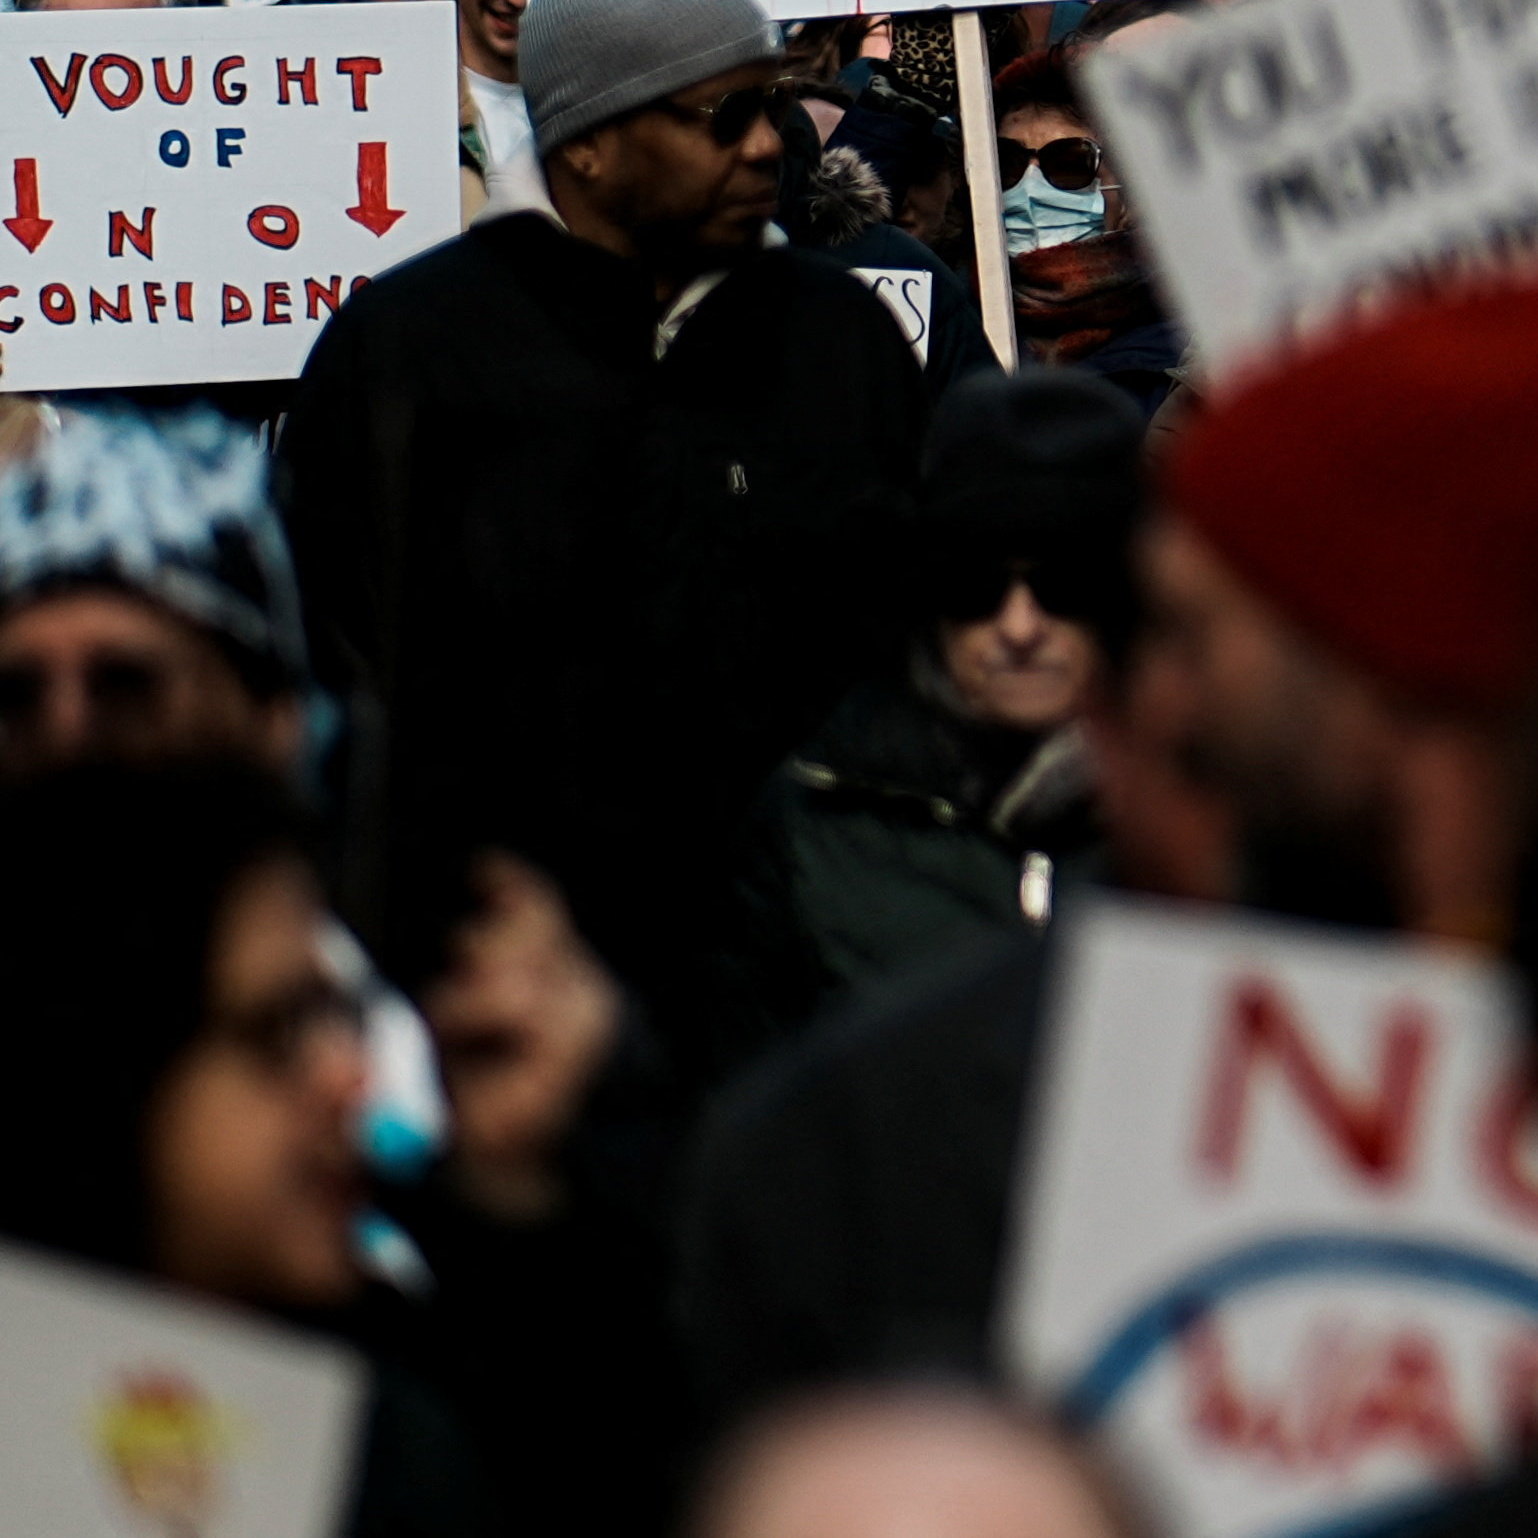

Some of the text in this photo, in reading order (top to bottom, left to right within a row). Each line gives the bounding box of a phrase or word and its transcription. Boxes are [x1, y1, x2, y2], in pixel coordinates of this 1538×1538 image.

[30, 52, 384, 118] VOUGHT
[1113, 3, 1355, 181] YOU
[158, 128, 246, 168] OF
[1240, 98, 1474, 255] MORE
[0, 275, 372, 334] CONFIDEN
